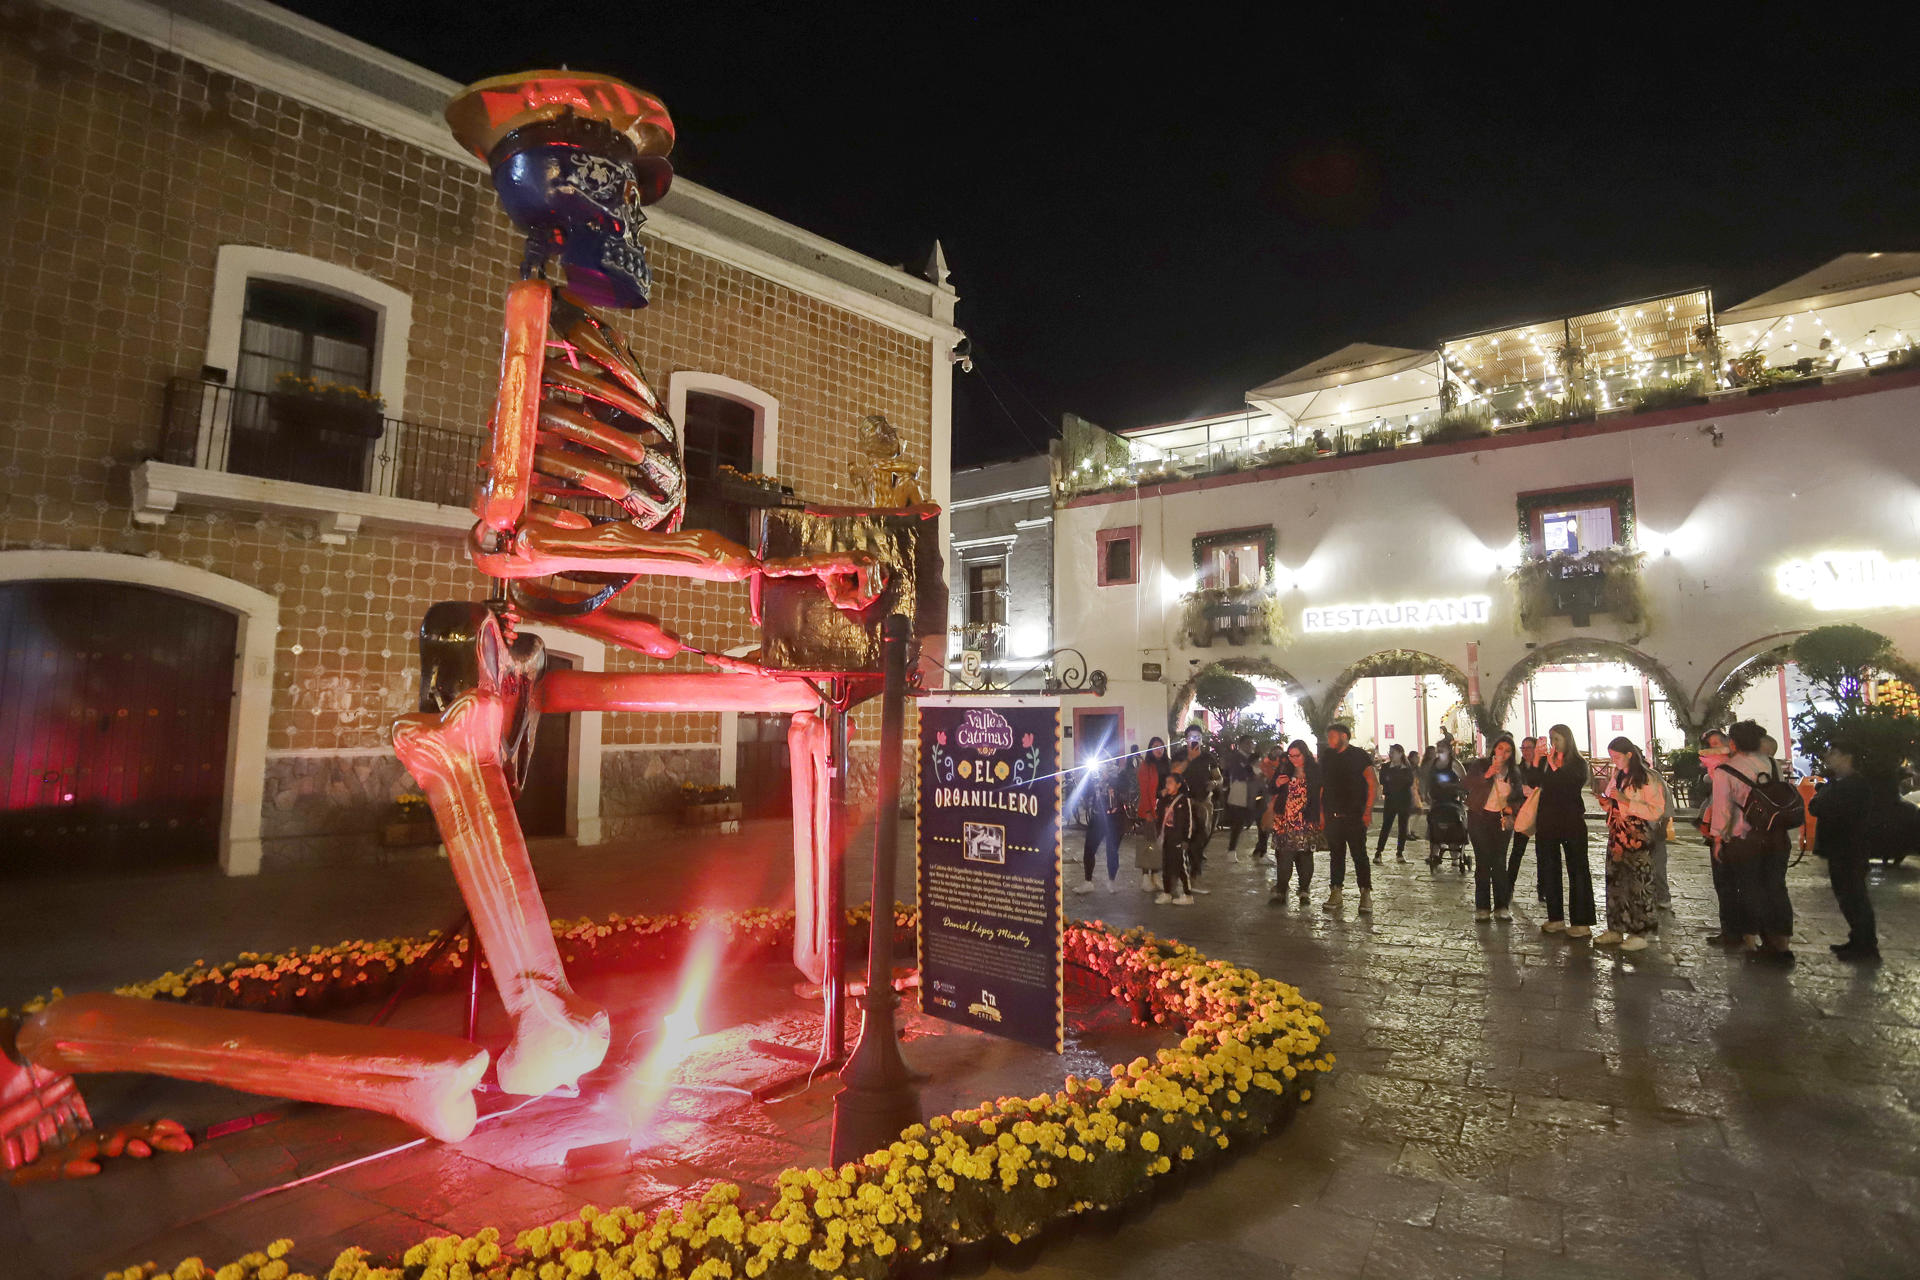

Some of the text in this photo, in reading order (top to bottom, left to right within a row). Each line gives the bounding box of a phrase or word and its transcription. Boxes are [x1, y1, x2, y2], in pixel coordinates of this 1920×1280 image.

[1305, 600, 1486, 629] RESTAURANT
[967, 713, 1004, 732] Valle de
[958, 729, 1009, 746] Catrinas
[975, 760, 994, 783] EL
[935, 788, 1038, 816] ORGANILLERO
[943, 916, 970, 931] Daniel
[972, 922, 994, 940] López
